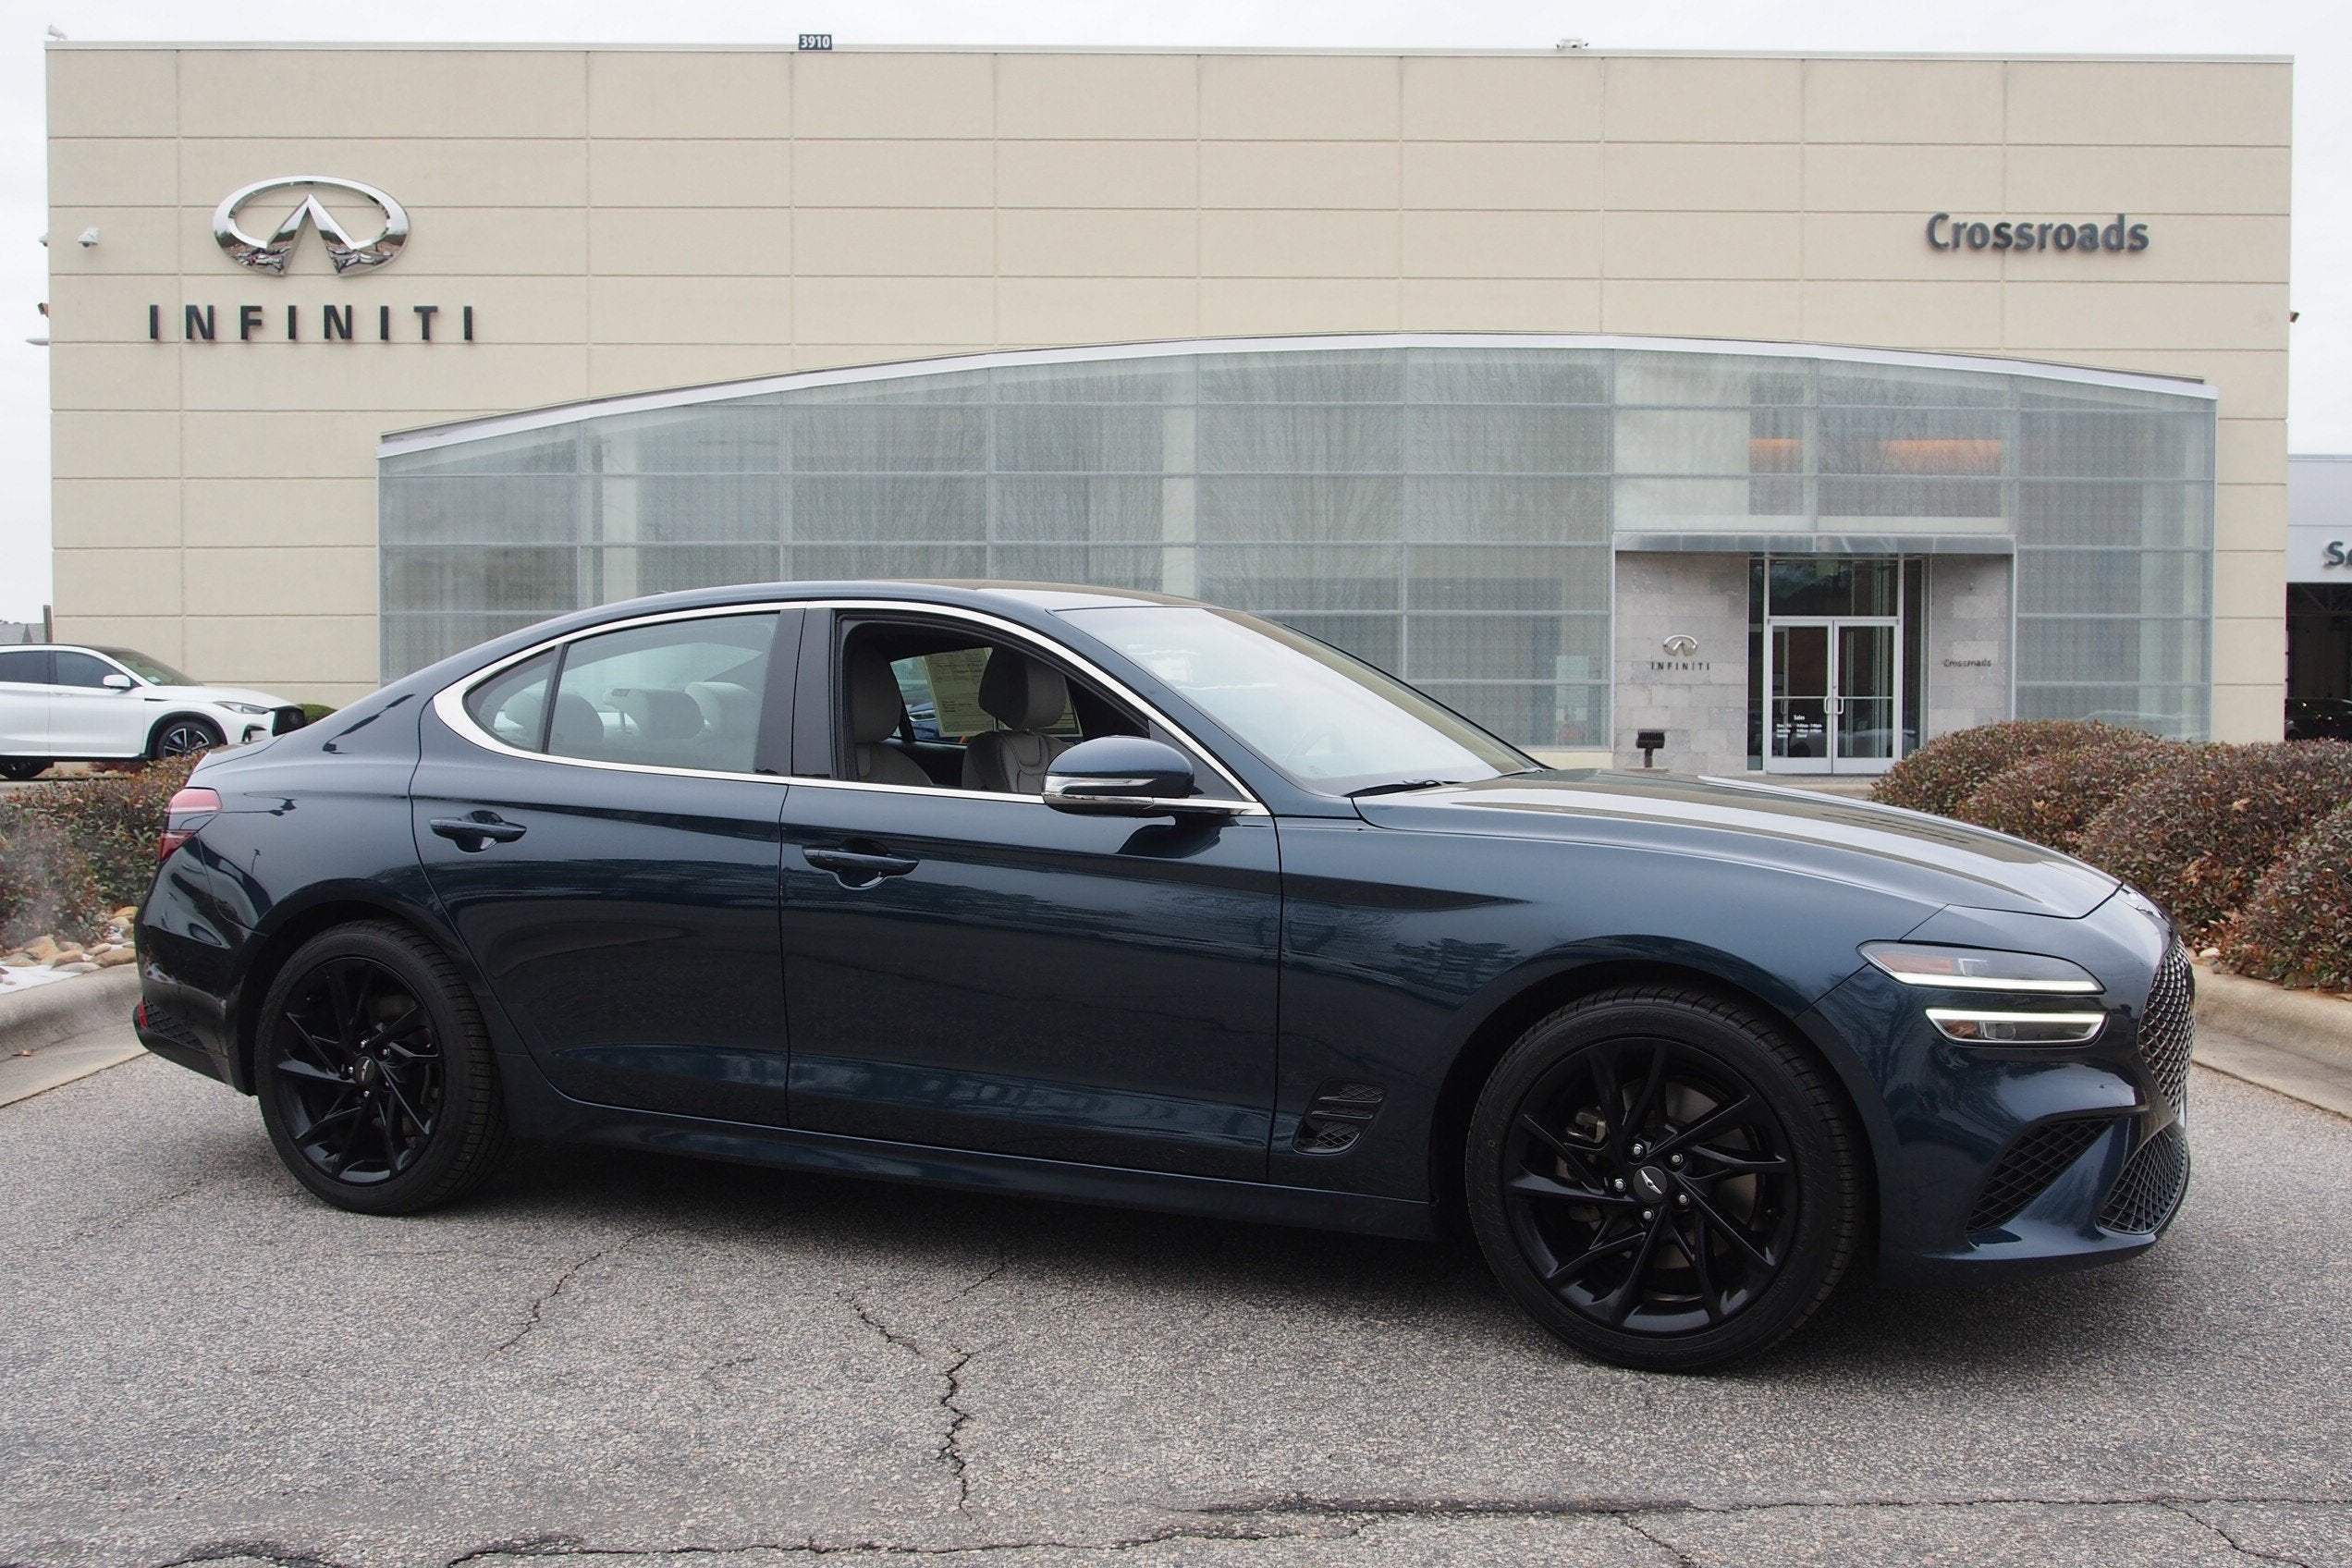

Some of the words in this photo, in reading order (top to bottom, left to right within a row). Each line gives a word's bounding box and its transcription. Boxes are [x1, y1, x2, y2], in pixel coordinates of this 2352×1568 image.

[801, 35, 830, 48] 3910
[1926, 213, 2150, 251] Crossroads
[149, 305, 473, 340] INFINITI
[1651, 662, 1709, 670] INFINITI
